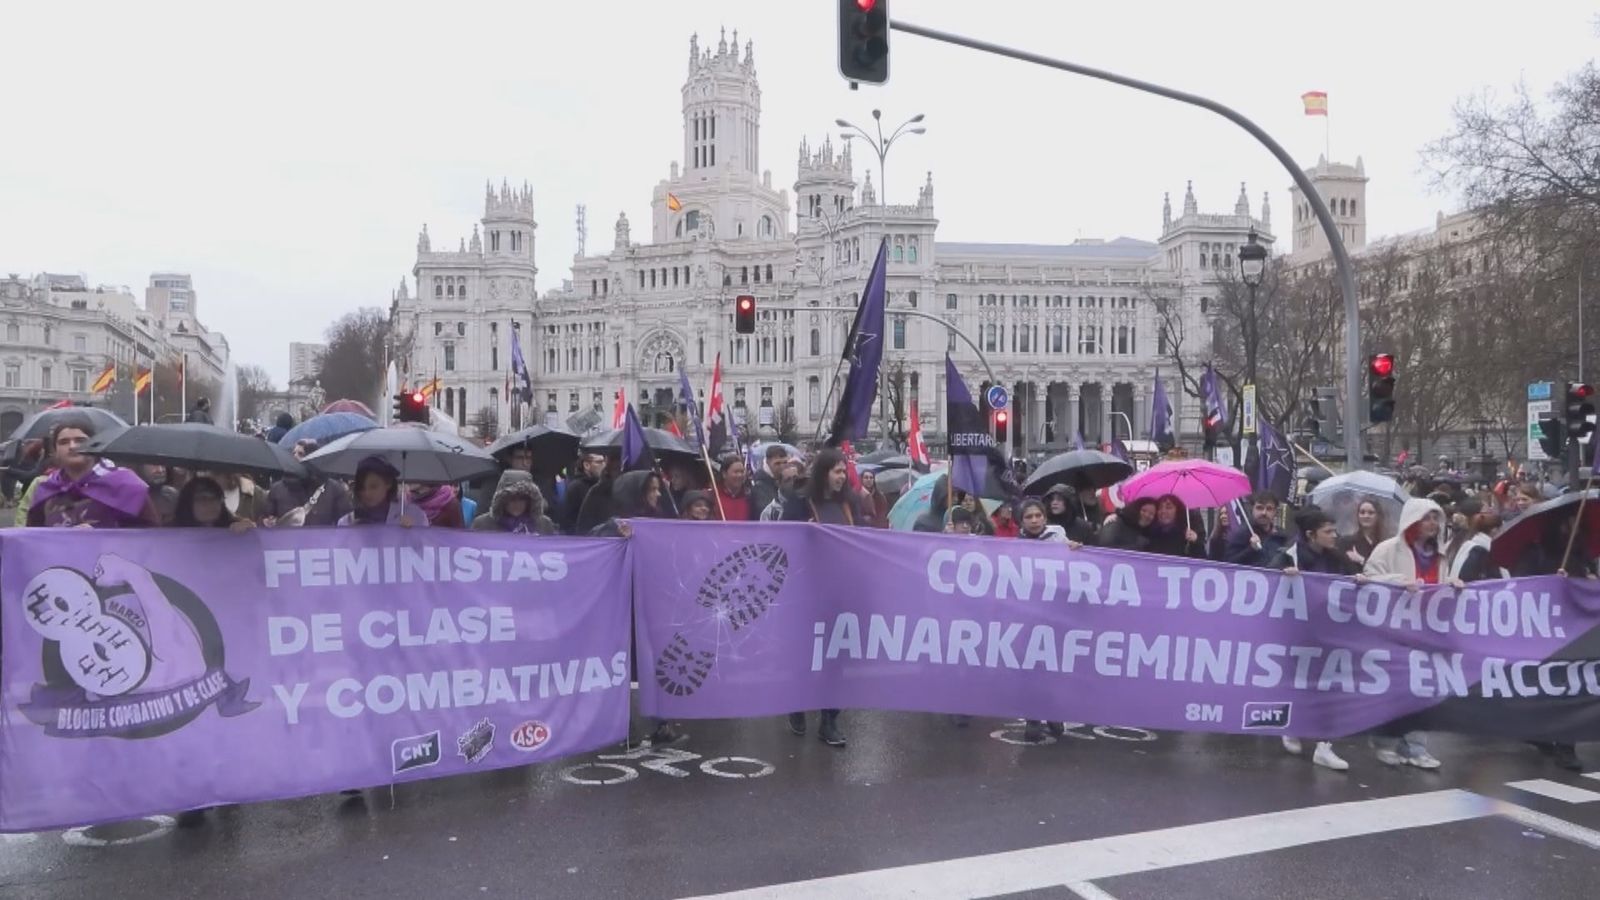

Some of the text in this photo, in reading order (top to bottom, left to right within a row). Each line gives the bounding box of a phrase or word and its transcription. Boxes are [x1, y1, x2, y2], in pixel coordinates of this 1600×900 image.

[264, 546, 568, 588] FEMINISTAS
[108, 601, 146, 628] MARZO
[927, 549, 1566, 638] CONTRA TODA COACCIÓN:
[268, 606, 516, 656] DE CLASE
[811, 612, 1391, 695] ¡ANARKAFEMINISTAS
[1409, 650, 1469, 698] EN
[58, 671, 228, 730] BLOQUE COMBATIVO Y DE CLASE
[272, 651, 627, 724] Y COMBATIVAS
[1184, 703, 1224, 723] 8M
[1250, 710, 1284, 722] CNT
[401, 742, 433, 761] CNT
[516, 726, 545, 746] ASC
